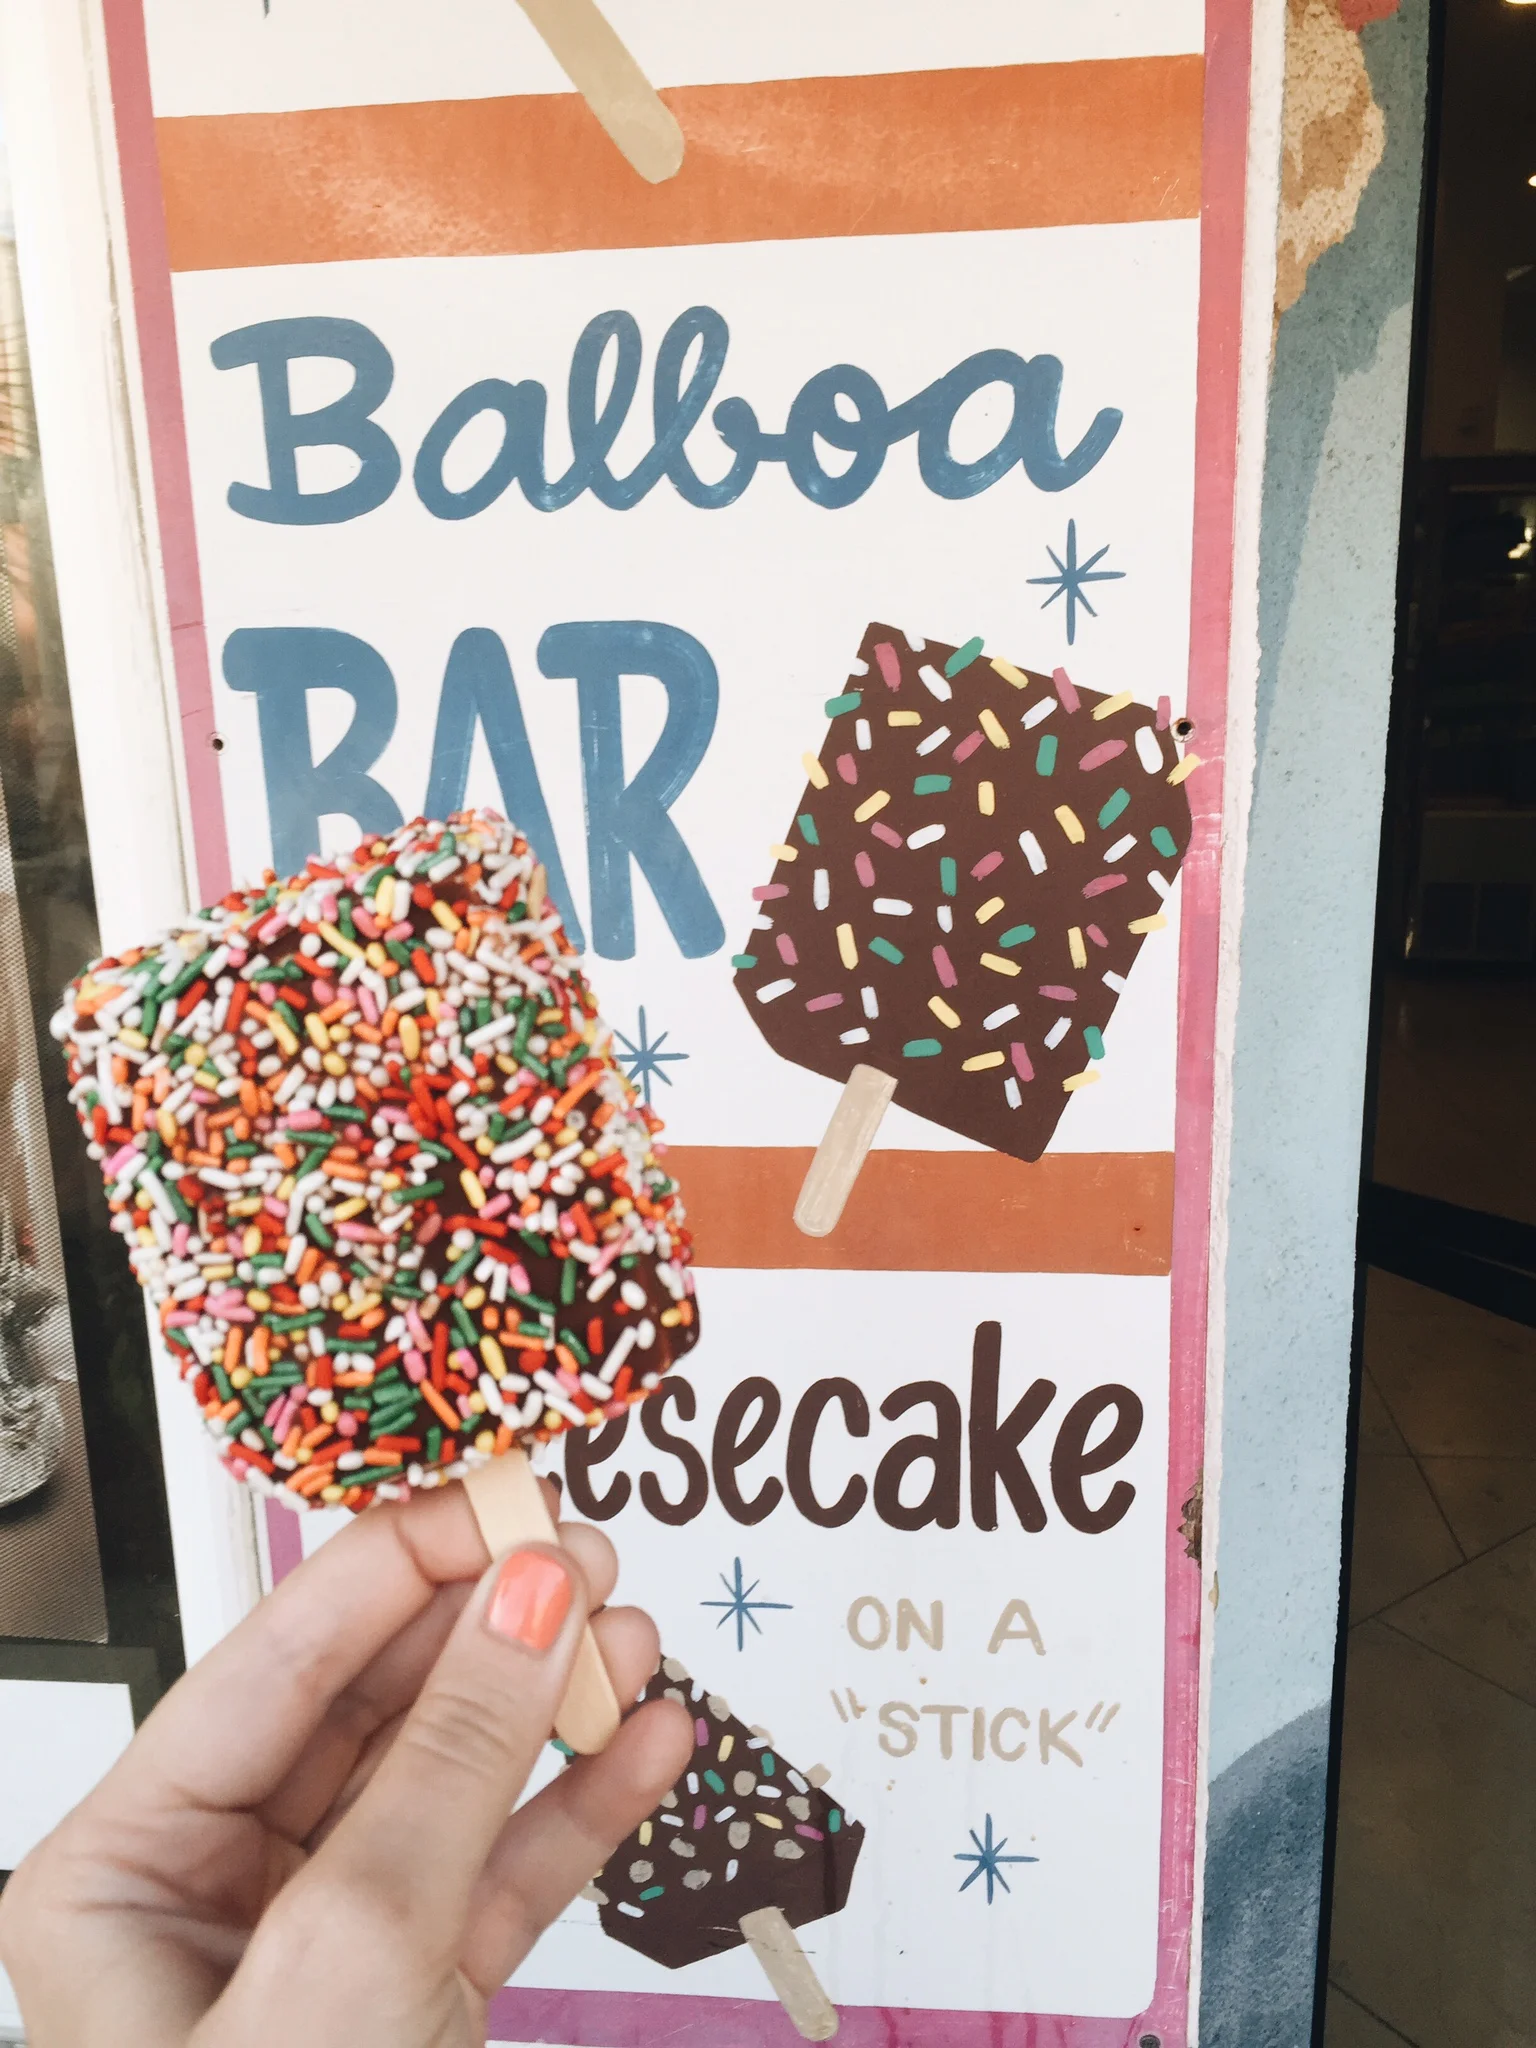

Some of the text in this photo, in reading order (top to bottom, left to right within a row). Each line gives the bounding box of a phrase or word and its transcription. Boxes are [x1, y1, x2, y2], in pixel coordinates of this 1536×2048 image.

[211, 306, 1123, 526] Balboa
[222, 620, 726, 961] BAR
[547, 1321, 1144, 1535] esecake
[830, 1687, 1121, 1768] "STICK"
[847, 1596, 1046, 1656] ON A
